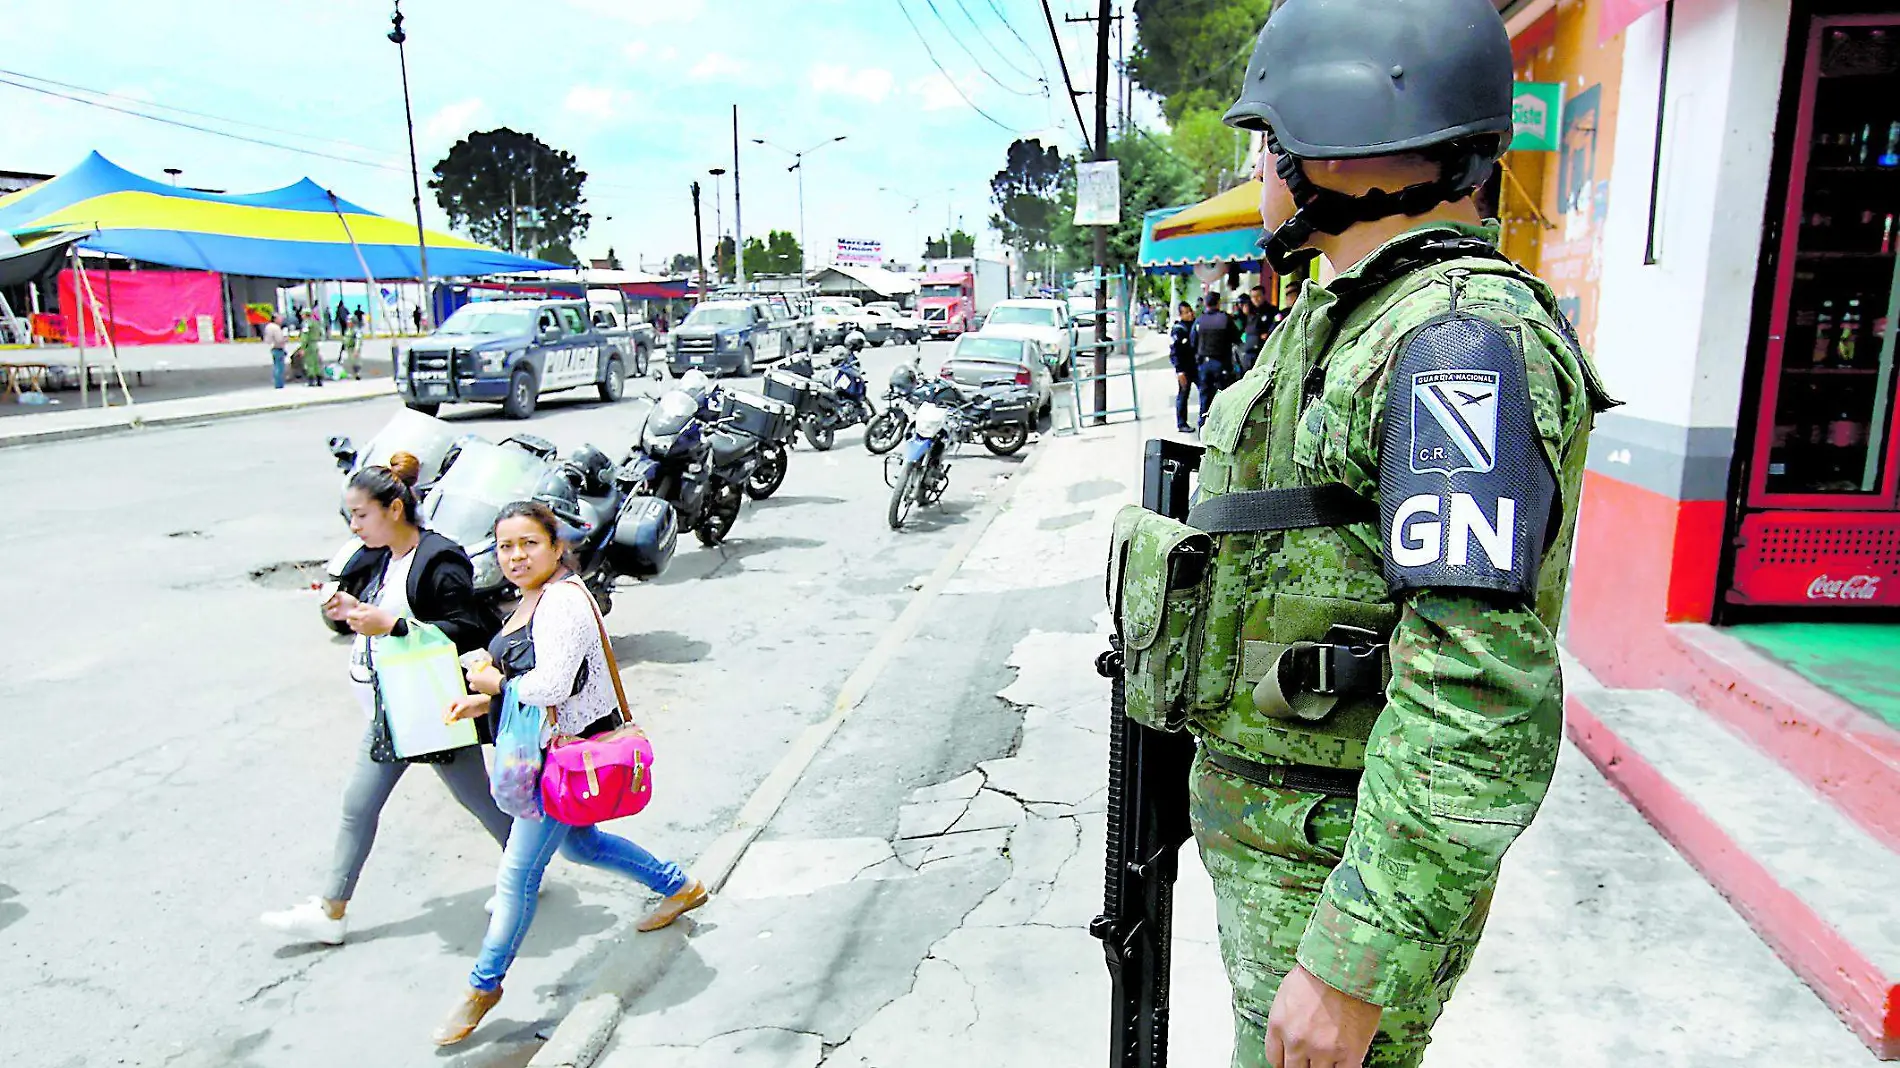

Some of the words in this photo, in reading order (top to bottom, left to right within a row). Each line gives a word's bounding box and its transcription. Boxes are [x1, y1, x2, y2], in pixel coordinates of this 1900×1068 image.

[1418, 374, 1454, 384] GUARDIA
[1454, 373, 1494, 383] NACIONAL
[1419, 447, 1449, 462] C.R.
[1391, 492, 1517, 572] GN
